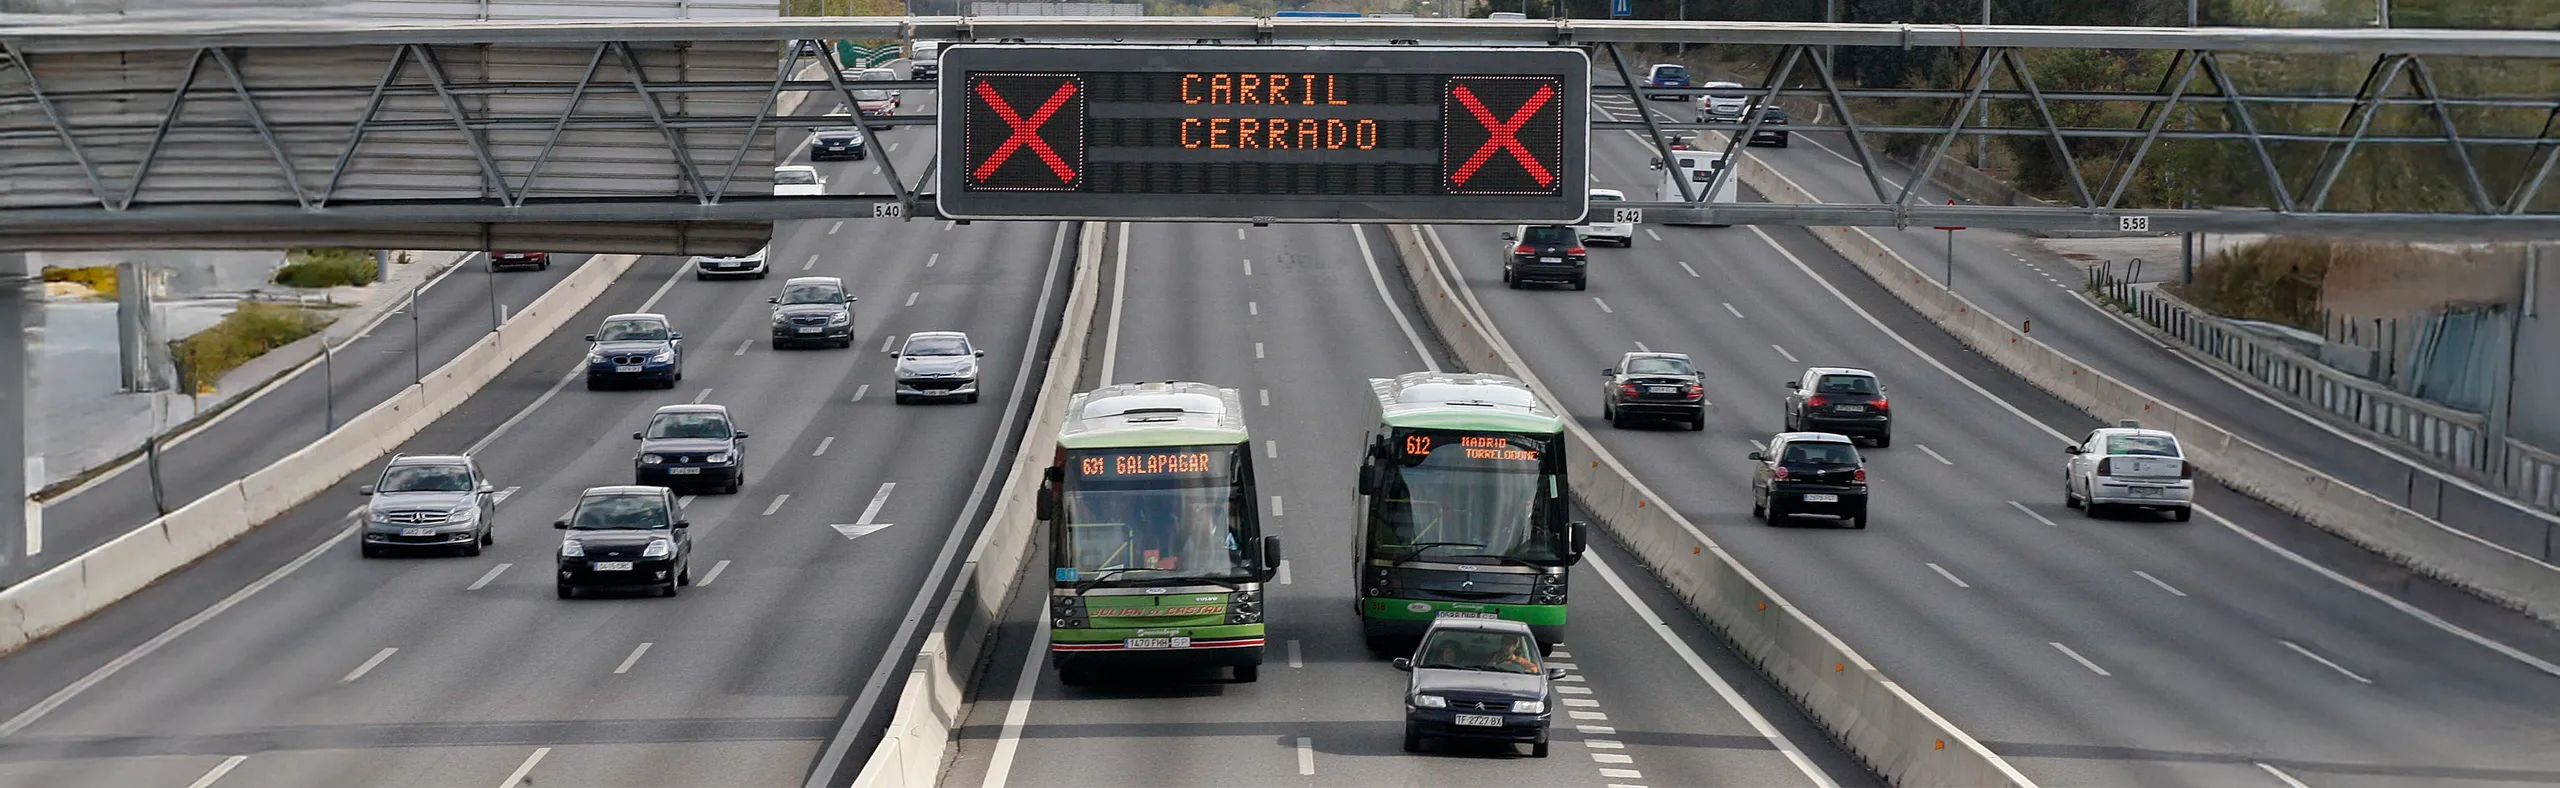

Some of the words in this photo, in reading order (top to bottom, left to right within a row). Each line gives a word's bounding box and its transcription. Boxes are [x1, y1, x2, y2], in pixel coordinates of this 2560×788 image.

[1182, 73, 1348, 105] CARRIL
[1181, 118, 1376, 149] CERRADO
[1406, 435, 1431, 455] 612
[1461, 436, 1508, 449] MADRID
[1083, 456, 1105, 475] 631
[1116, 453, 1210, 474] GALAPAGAR
